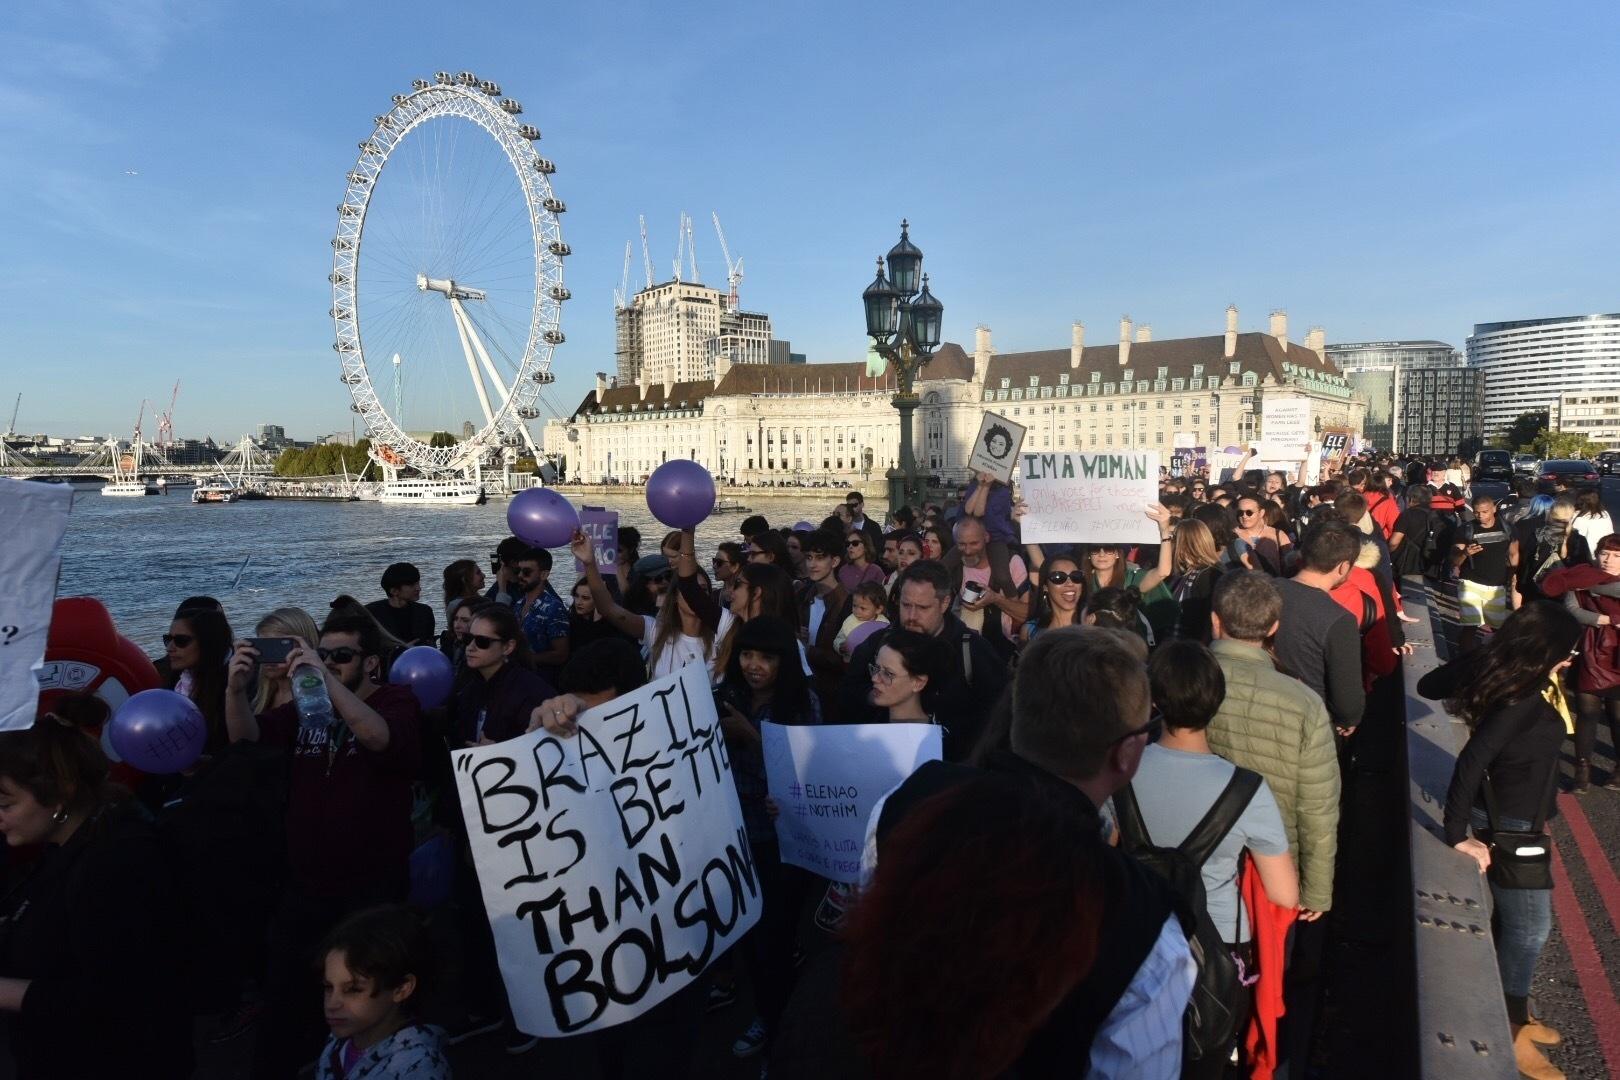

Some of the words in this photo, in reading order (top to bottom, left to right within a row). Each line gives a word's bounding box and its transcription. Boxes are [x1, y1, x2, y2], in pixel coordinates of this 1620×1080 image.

[1024, 452, 1057, 480] I'M
[1062, 454, 1075, 479] A
[1080, 454, 1147, 480] WOMAN
[1325, 435, 1345, 447] ELE
[1059, 486, 1087, 498] vote
[1107, 483, 1147, 498] those
[498, 809, 586, 889] IS
[515, 833, 681, 954] THAN
[544, 826, 759, 1033] BOLSON
